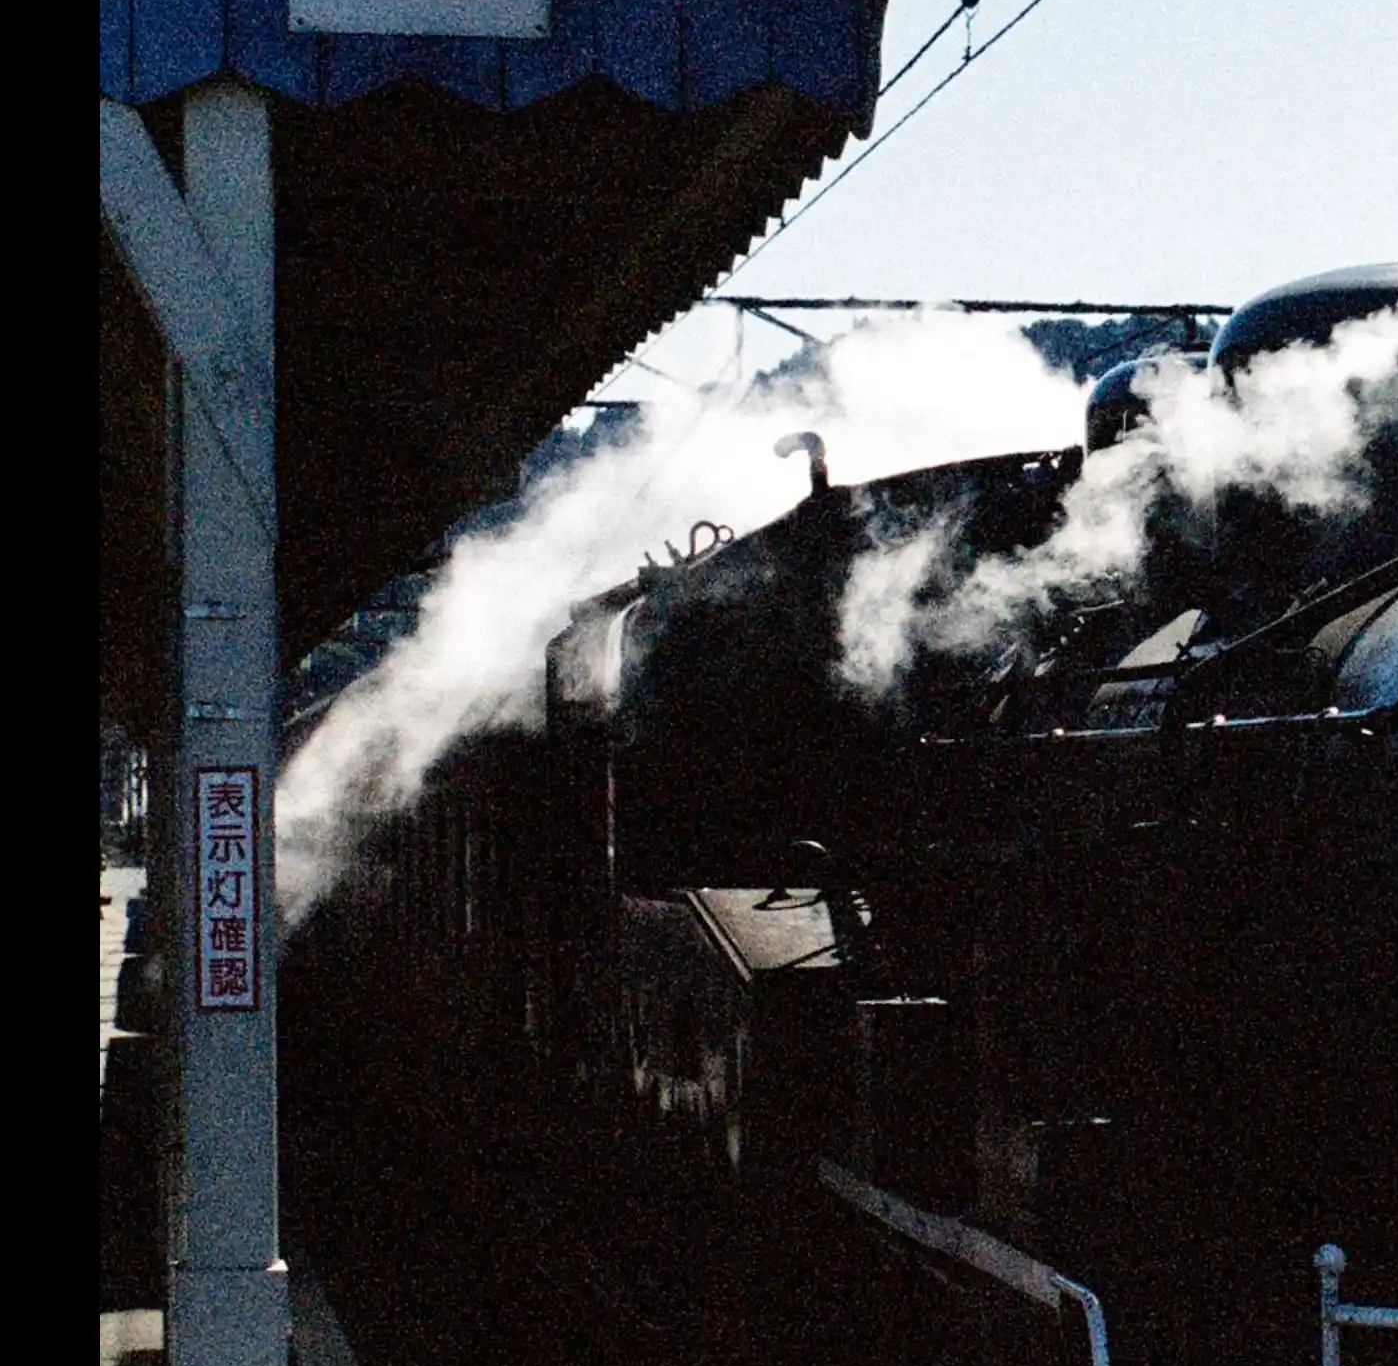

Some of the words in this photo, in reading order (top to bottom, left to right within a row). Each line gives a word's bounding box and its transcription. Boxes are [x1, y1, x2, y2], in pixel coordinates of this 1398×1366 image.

[207, 782, 248, 997] 表示灯確認
